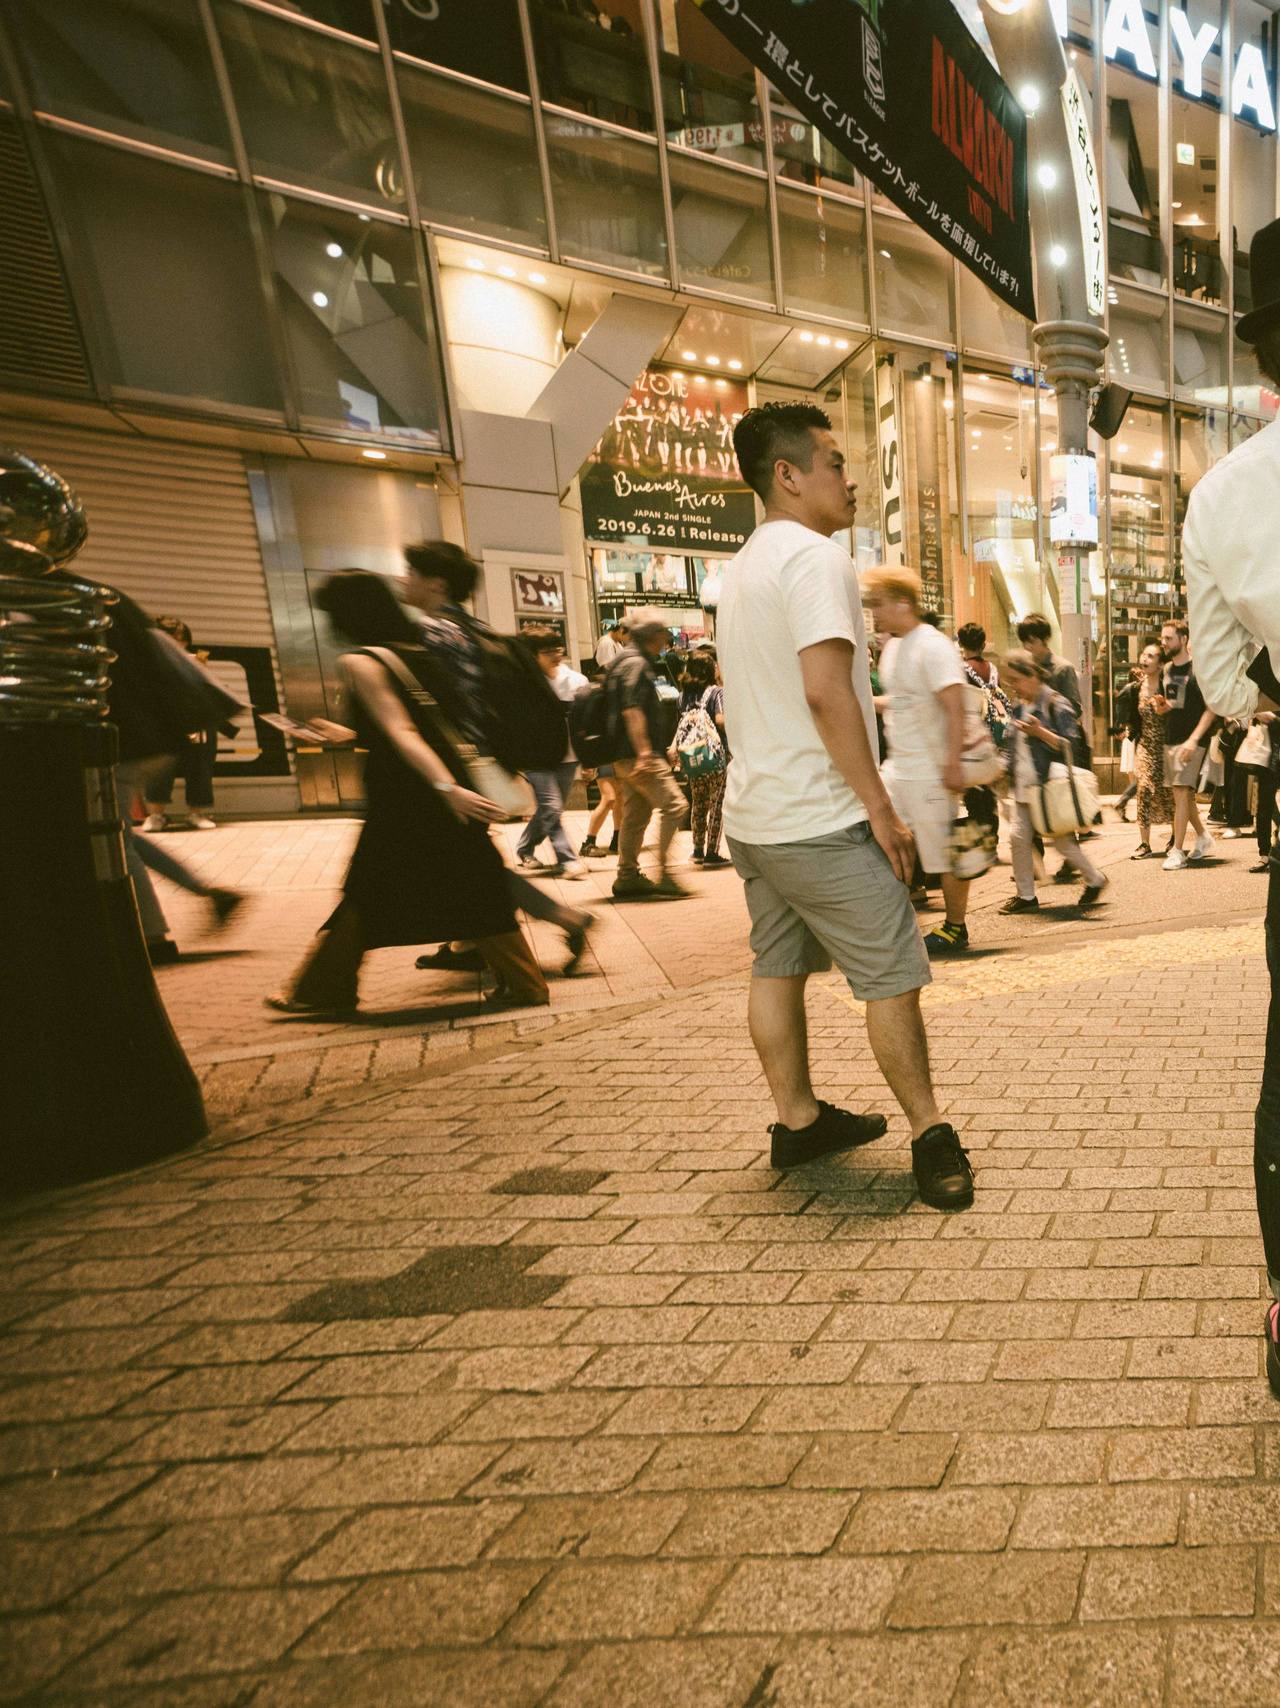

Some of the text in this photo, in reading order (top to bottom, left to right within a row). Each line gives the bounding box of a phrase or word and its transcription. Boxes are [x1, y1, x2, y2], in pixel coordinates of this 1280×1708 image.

[1049, 0, 1277, 130] AYA
[613, 470, 681, 497] Buenos
[675, 485, 726, 510] Aires
[633, 508, 712, 525] JAPAN 2nd SINGLE
[598, 518, 676, 537] 2019.6.26
[689, 527, 745, 545] Release
